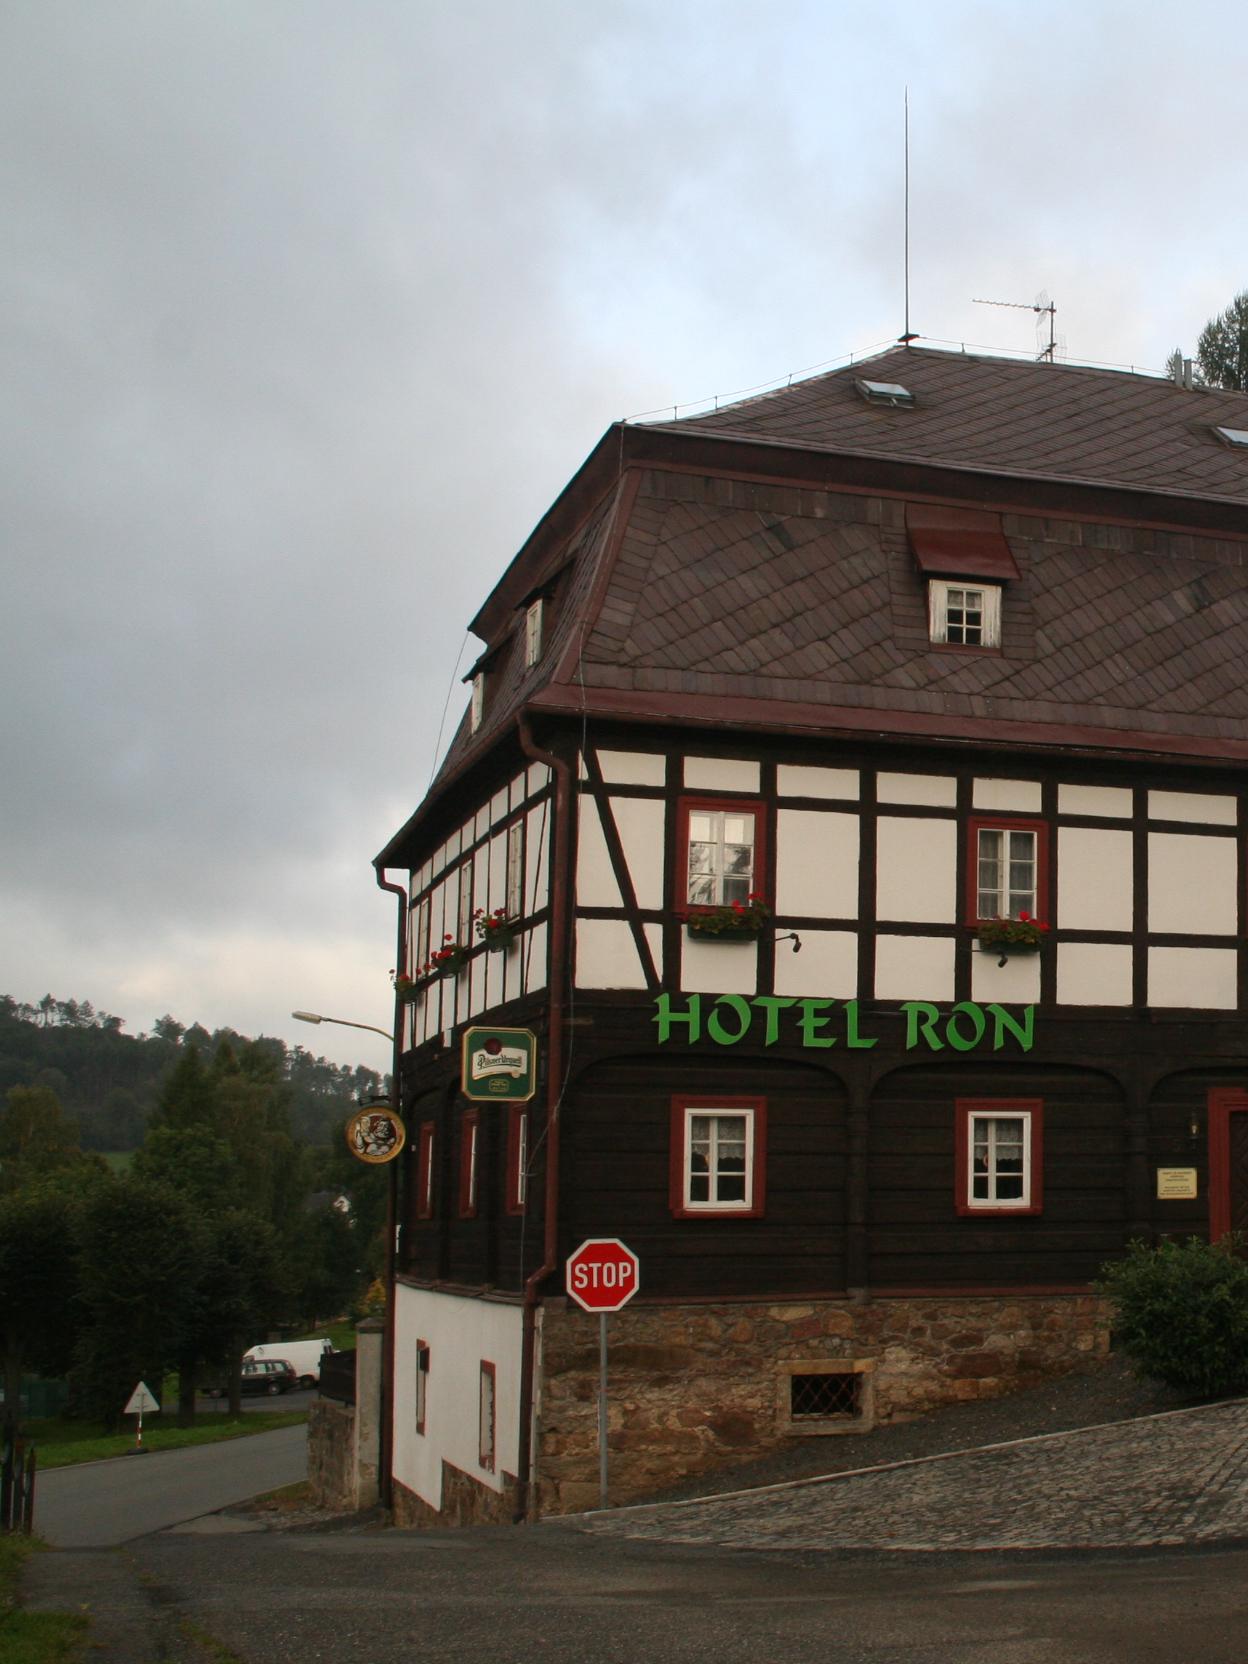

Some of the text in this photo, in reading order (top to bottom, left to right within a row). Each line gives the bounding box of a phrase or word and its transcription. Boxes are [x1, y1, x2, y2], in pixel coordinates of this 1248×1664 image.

[651, 992, 1034, 1053] HOTEL RON
[574, 1262, 632, 1289] STOP
